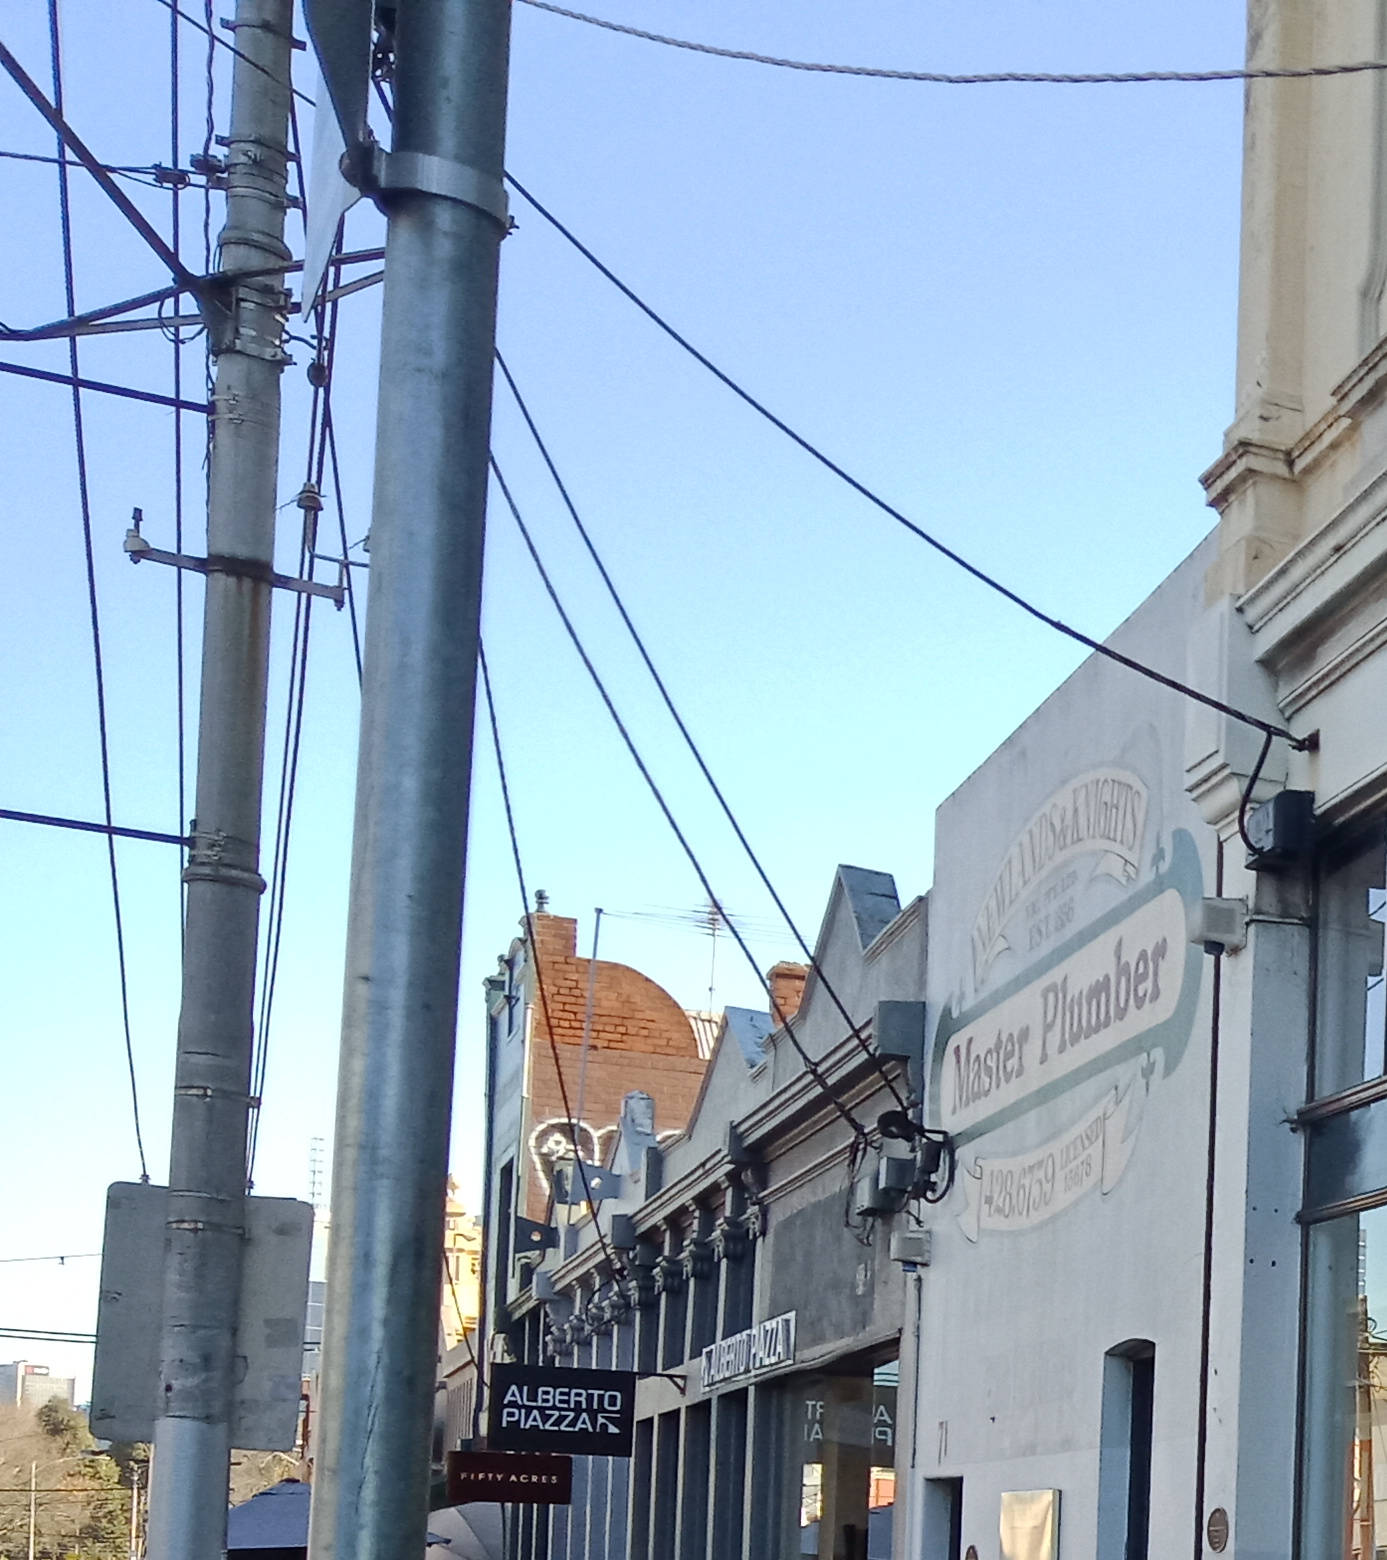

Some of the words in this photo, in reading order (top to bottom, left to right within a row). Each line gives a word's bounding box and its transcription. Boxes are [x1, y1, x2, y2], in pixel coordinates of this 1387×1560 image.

[952, 1024, 1030, 1116] Master
[1040, 936, 1167, 1064] Plumber
[503, 1384, 622, 1411] ALBERTO
[502, 1407, 593, 1433] PIAZZA
[460, 1472, 504, 1483] FIFTY
[509, 1474, 558, 1485] ACRES
